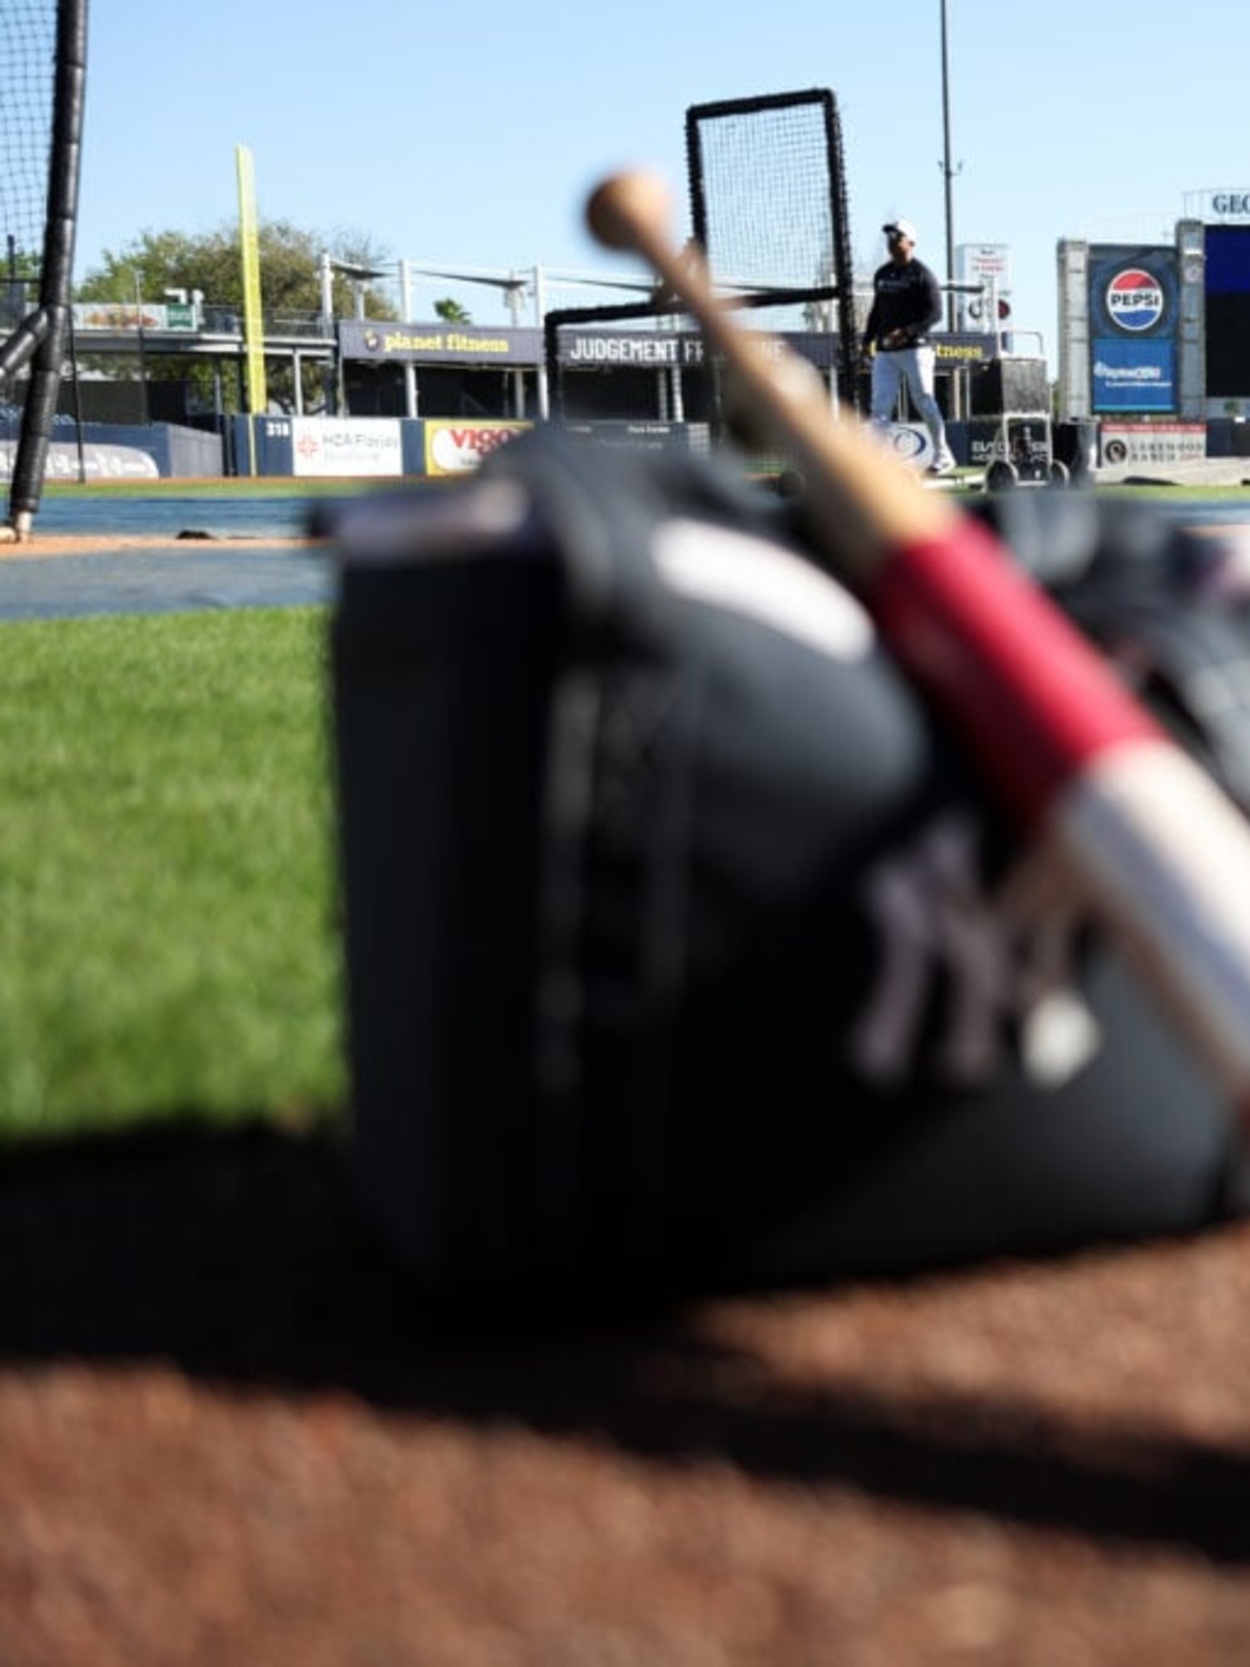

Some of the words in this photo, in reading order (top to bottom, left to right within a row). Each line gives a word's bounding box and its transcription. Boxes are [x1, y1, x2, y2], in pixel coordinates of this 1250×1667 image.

[1110, 293, 1159, 307] PEPSI
[384, 329, 442, 352] planet
[446, 332, 509, 353] fitness
[570, 338, 679, 361] JUDGEMENT
[936, 343, 982, 358] tness
